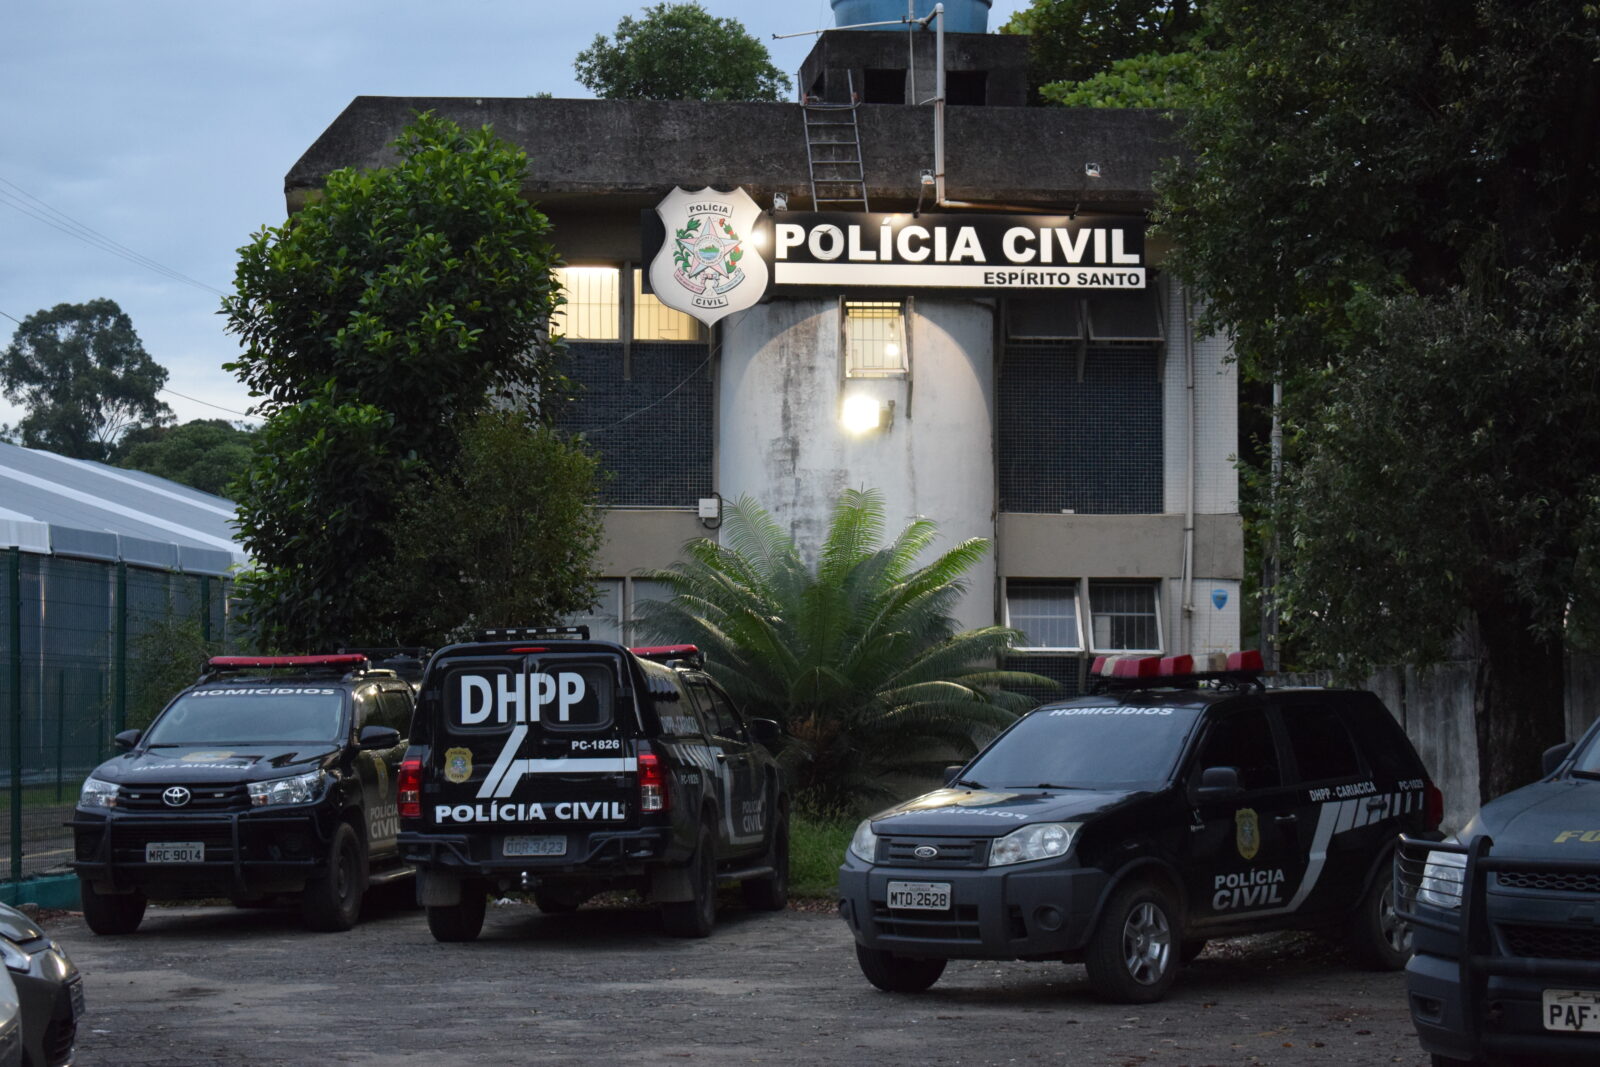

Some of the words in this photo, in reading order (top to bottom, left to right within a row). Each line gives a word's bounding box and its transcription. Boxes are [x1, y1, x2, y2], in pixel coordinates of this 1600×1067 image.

[689, 203, 728, 213] POLÍCIA
[775, 217, 986, 263] POLÍCIA
[1002, 226, 1140, 264] CIVIL
[983, 269, 1071, 285] ESPÍRITO
[1077, 271, 1141, 286] SANTO
[695, 298, 723, 306] CIVIL
[192, 688, 335, 697] HOMICÍDIOS
[460, 672, 586, 724] DHPP
[1049, 706, 1174, 718] HOMICÍDIOS
[571, 739, 620, 750] PC-1826
[1309, 788, 1331, 802] DHPP
[1336, 781, 1377, 798] CARIACICA
[435, 800, 547, 824] POLÍCIA
[555, 801, 625, 820] CIVIL
[371, 818, 401, 839] CIVIL
[743, 815, 763, 833] CIVIL
[1213, 867, 1285, 890] POLÍCIA
[1212, 884, 1282, 911] CIVIL
